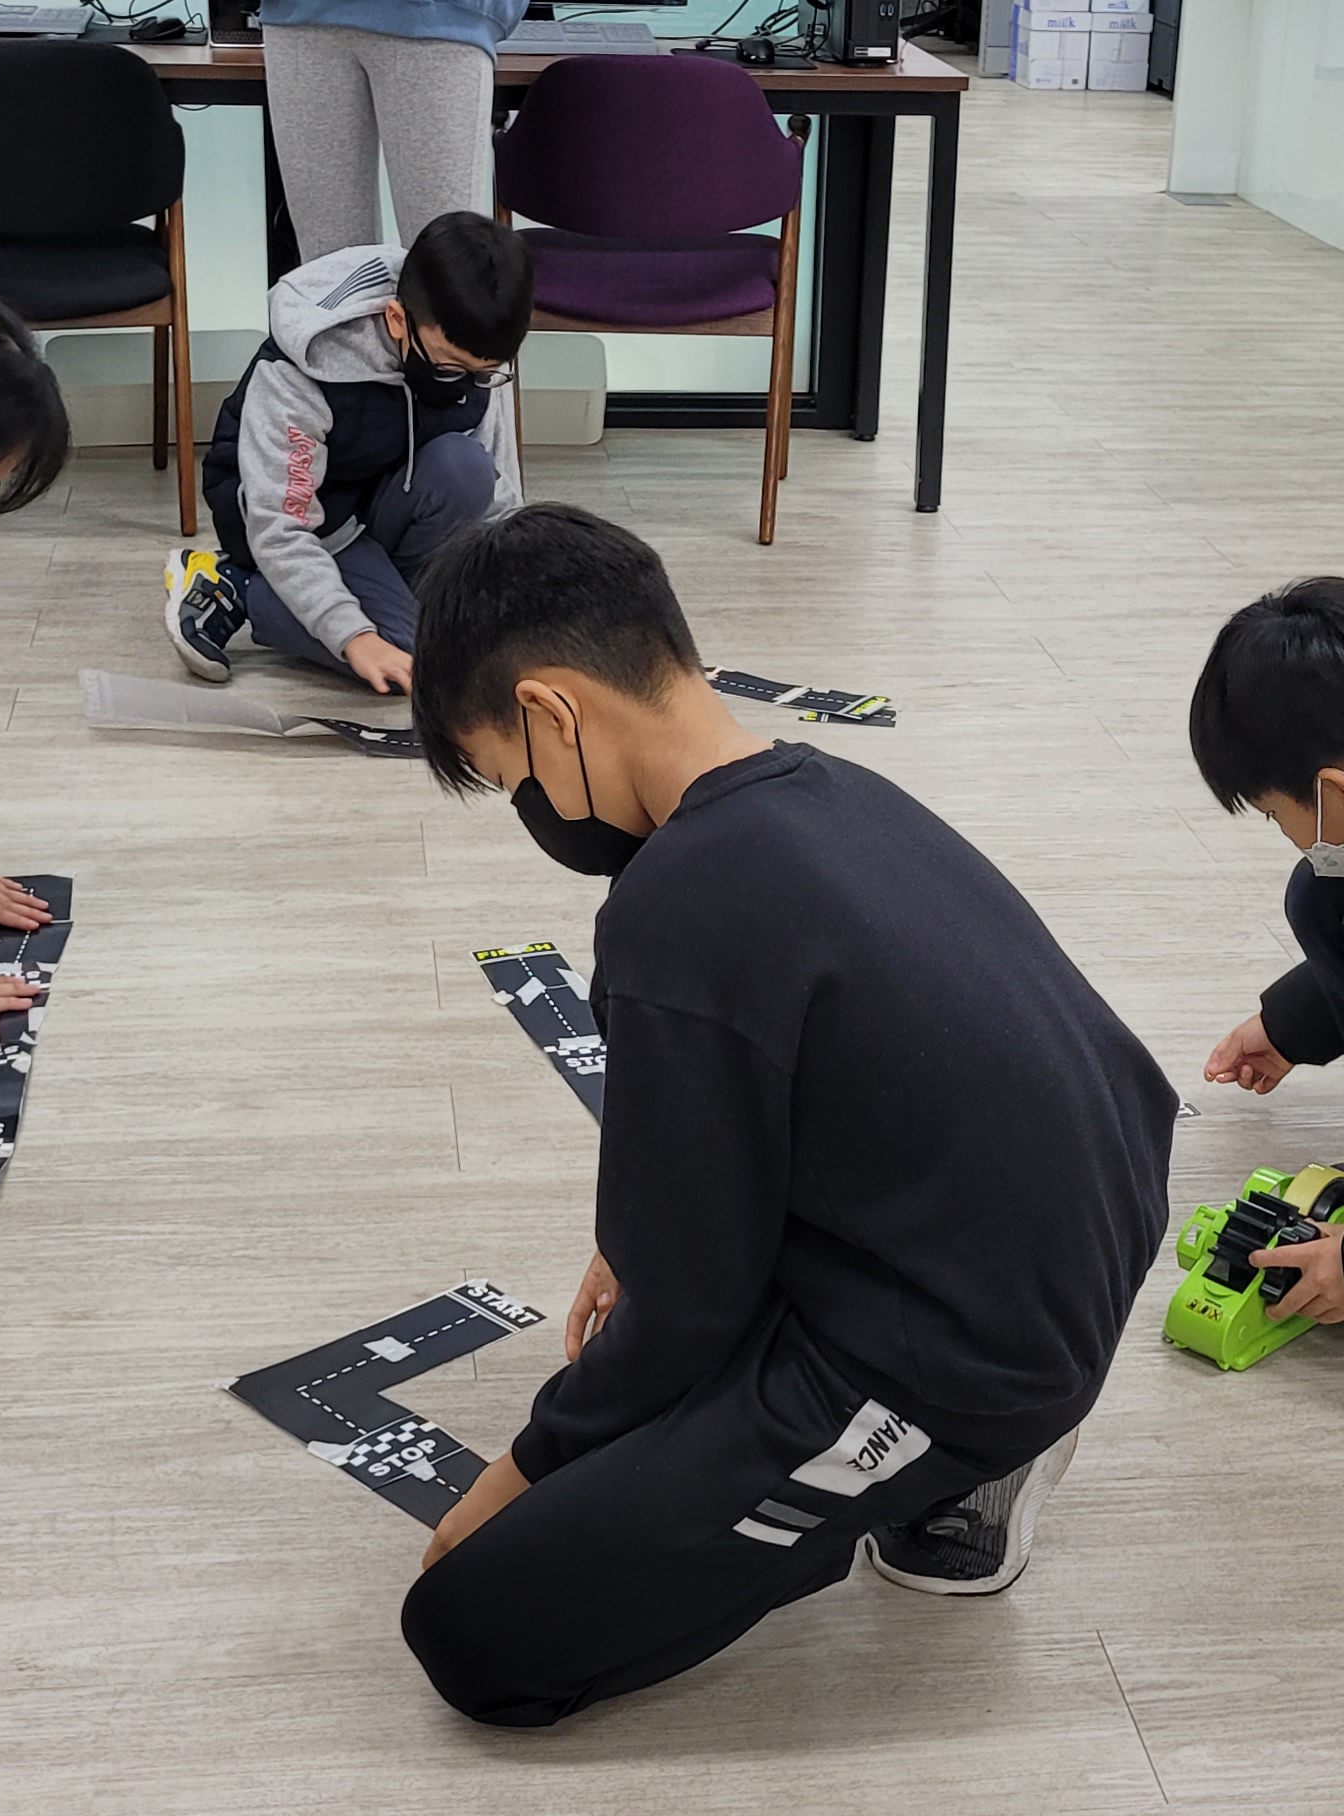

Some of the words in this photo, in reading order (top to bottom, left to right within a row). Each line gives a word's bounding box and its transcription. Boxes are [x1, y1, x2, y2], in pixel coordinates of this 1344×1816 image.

[564, 1054, 606, 1068] STO
[467, 1284, 541, 1326] START
[367, 1438, 438, 1478] STOP
